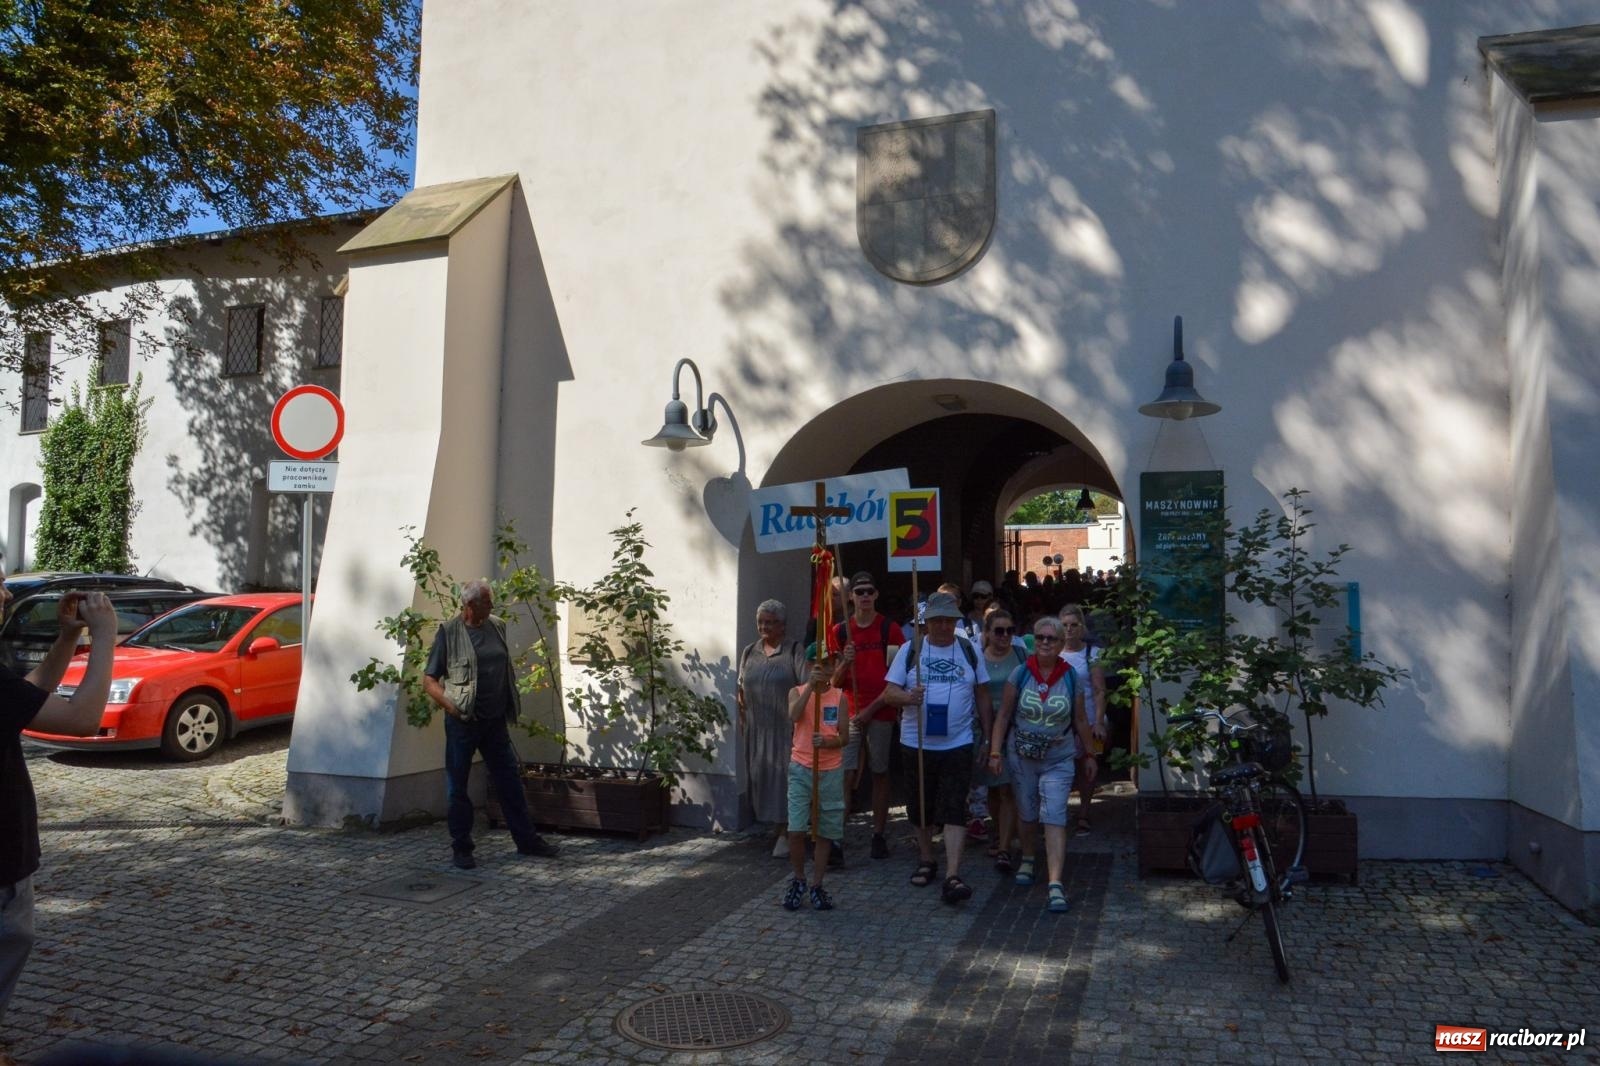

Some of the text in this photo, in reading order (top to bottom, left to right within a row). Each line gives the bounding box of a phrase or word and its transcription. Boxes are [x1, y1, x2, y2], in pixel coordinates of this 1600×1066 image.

[300, 466, 326, 474] dotyczy
[1145, 500, 1219, 511] MASZYNOWNIA
[896, 497, 932, 550] 5
[1020, 688, 1071, 727] 52
